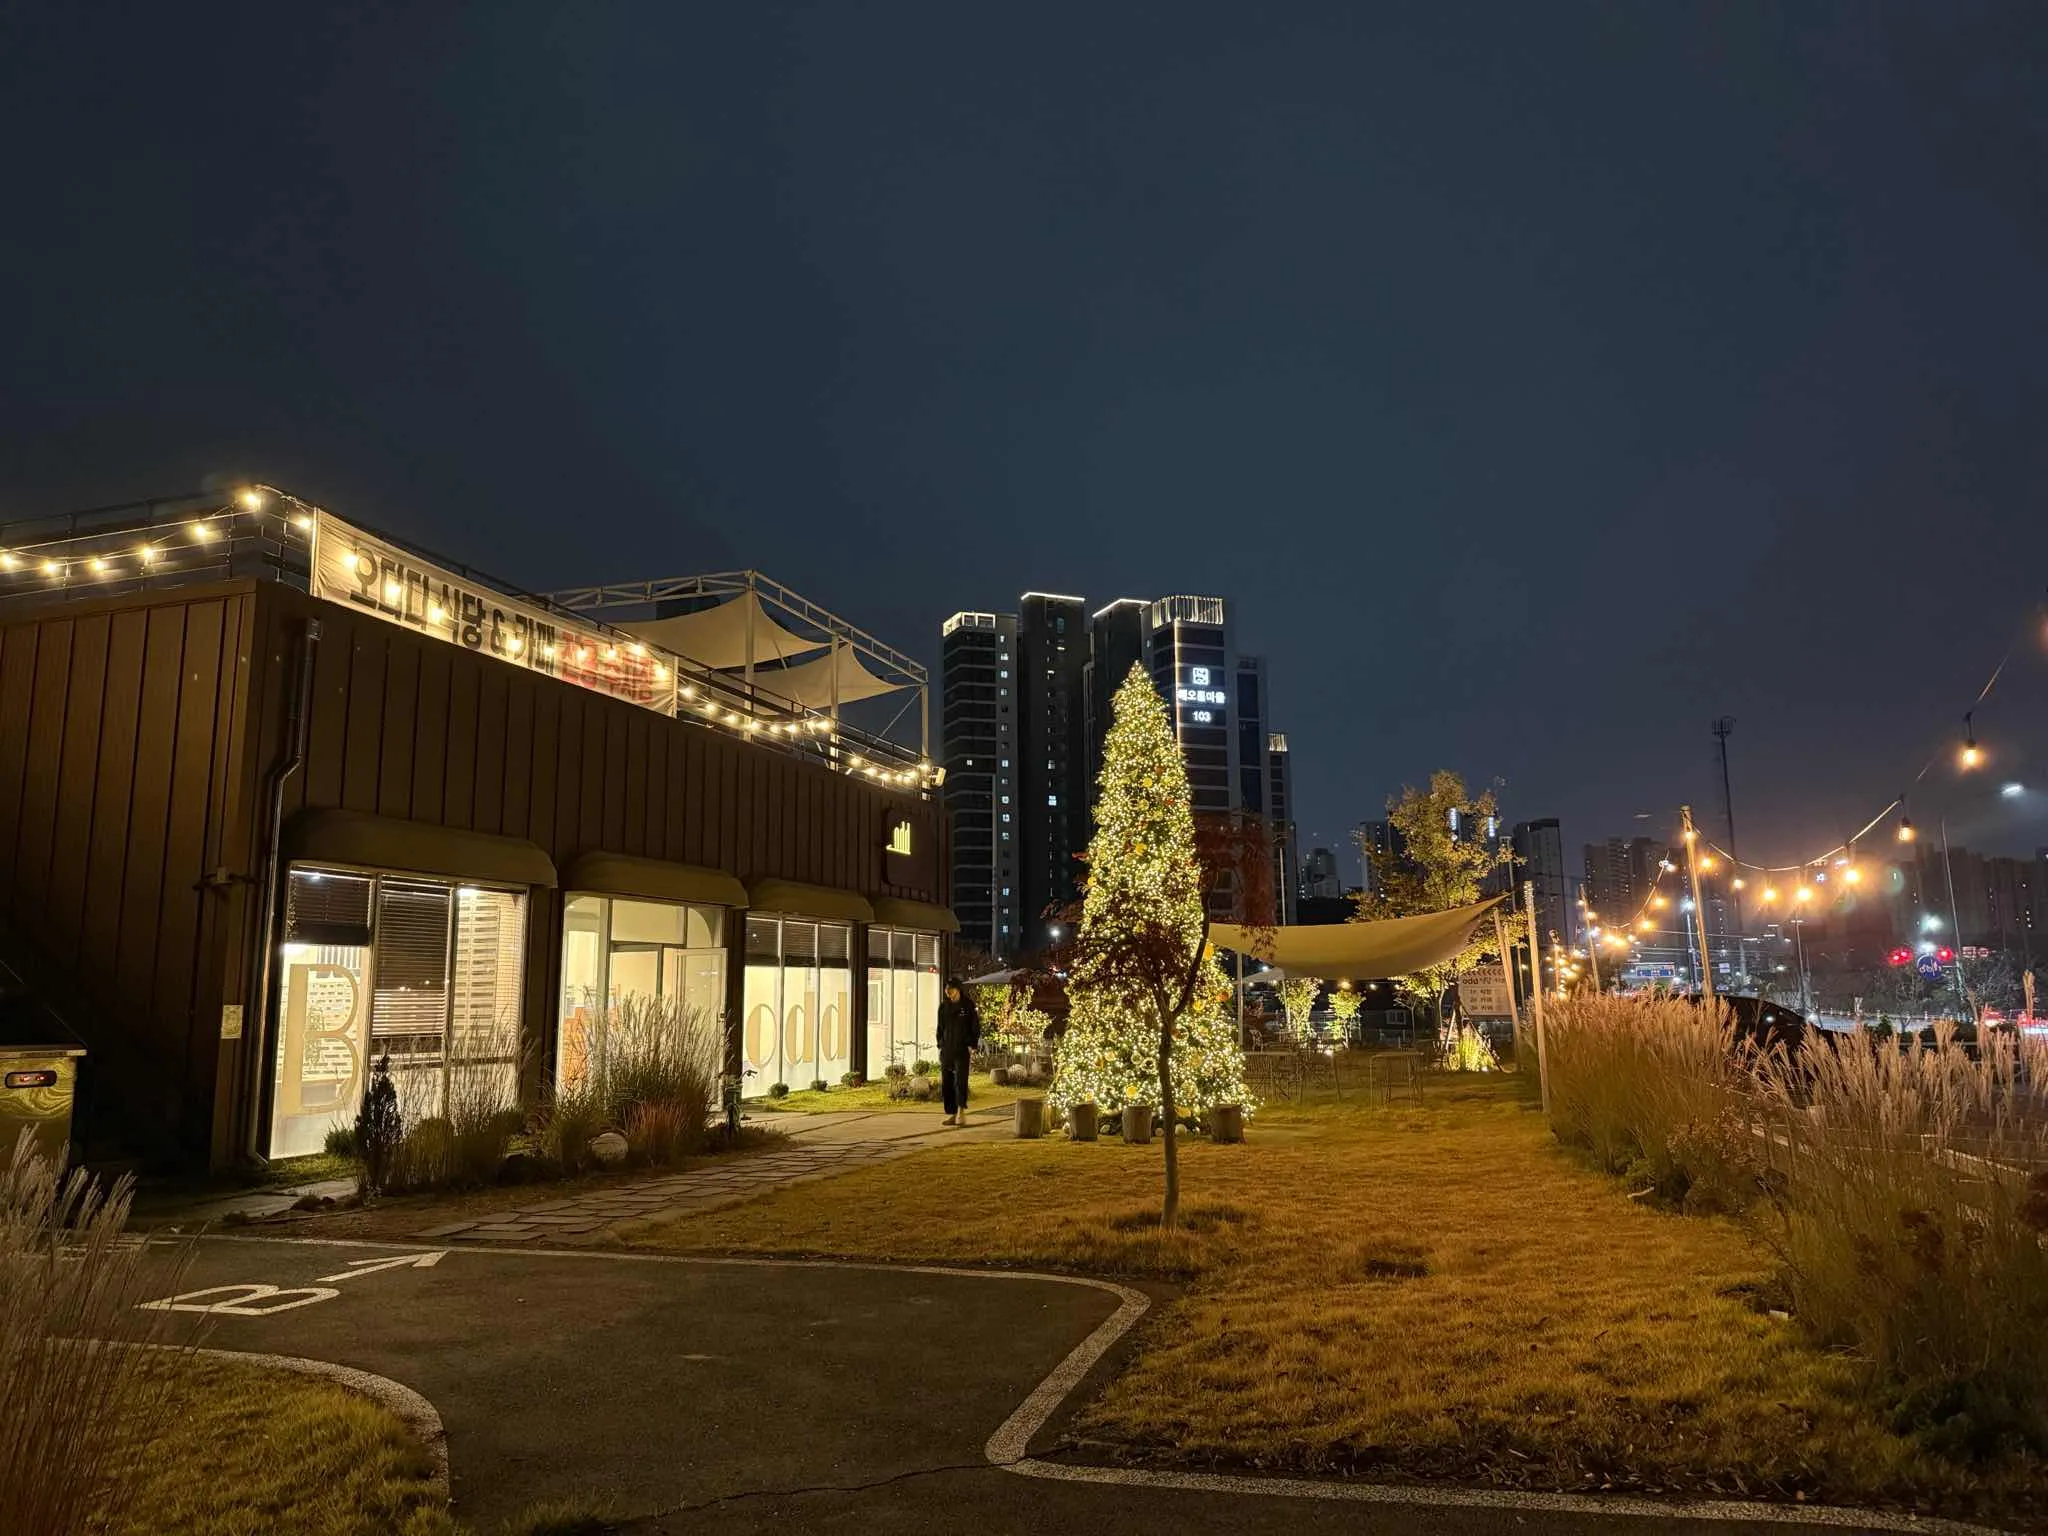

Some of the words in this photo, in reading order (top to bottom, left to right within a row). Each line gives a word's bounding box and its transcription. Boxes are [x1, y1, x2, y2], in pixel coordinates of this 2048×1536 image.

[434, 583, 486, 649] 식당
[490, 608, 507, 656] &
[513, 614, 556, 675] 카페
[1193, 711, 1212, 723] 103
[746, 991, 847, 1069] odd
